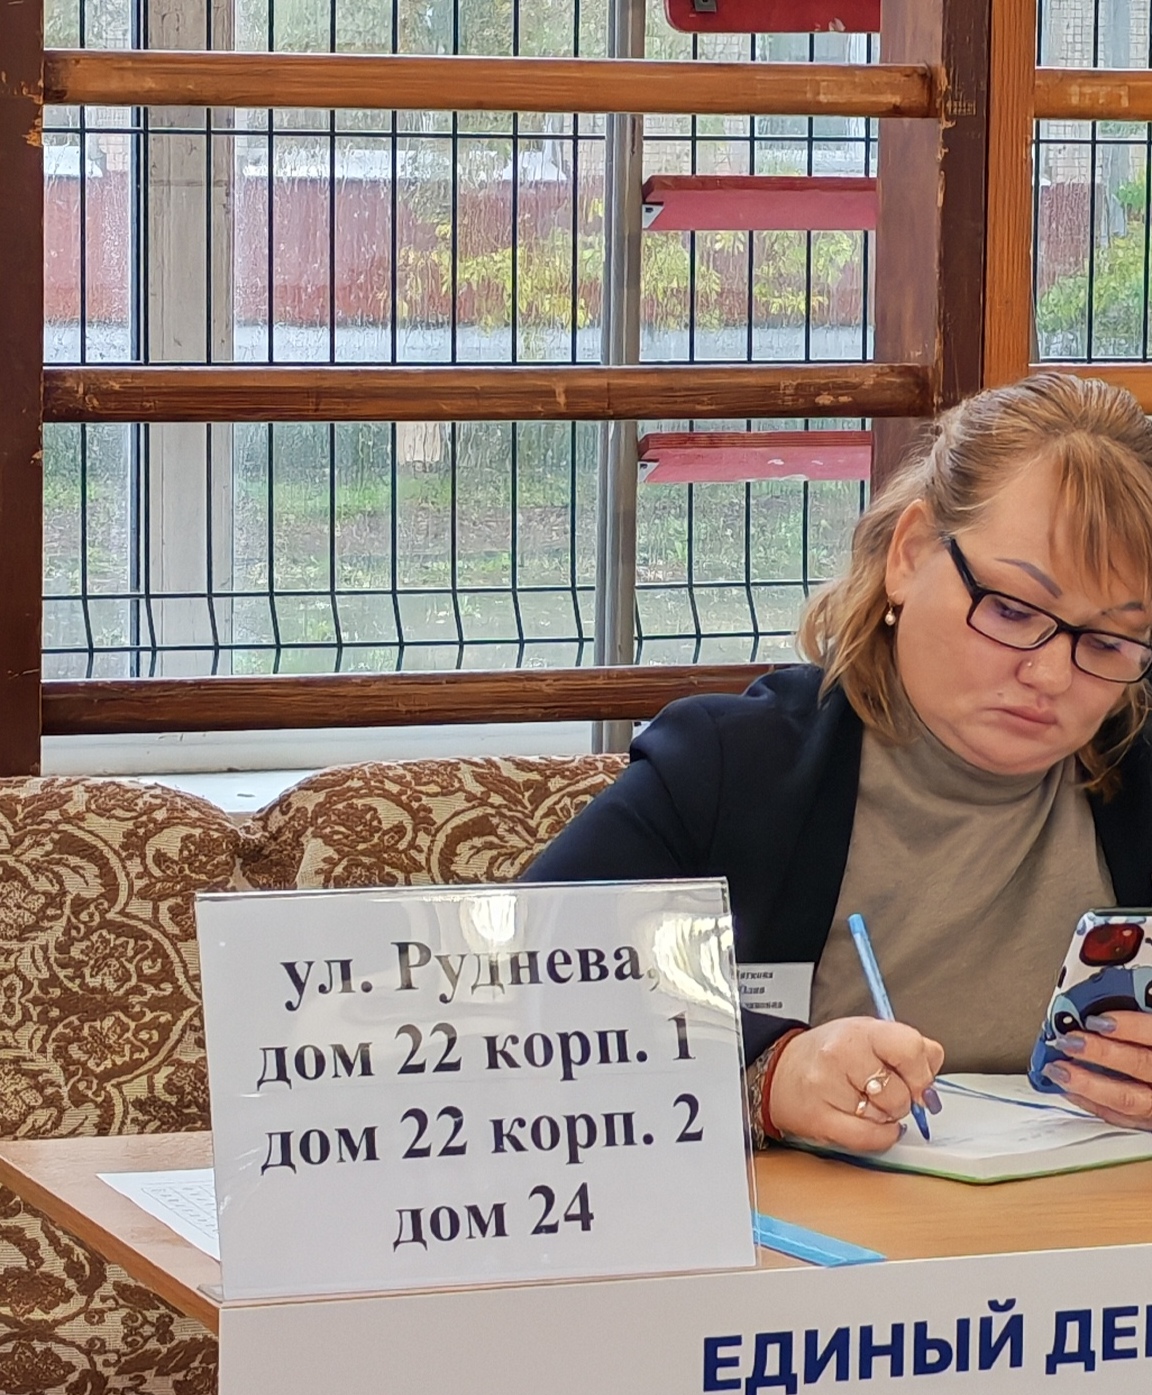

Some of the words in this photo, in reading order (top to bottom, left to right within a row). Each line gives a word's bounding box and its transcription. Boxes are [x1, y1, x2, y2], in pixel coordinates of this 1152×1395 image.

[279, 957, 373, 1012] ул.
[255, 1041, 375, 1091] дом
[395, 1022, 462, 1075] 22
[483, 1028, 648, 1082] корп.
[668, 1010, 694, 1061] 1
[260, 1125, 380, 1176] дом
[400, 1105, 468, 1160] 22
[489, 1114, 654, 1165] корп.
[673, 1093, 704, 1143] 2
[392, 1202, 509, 1252] дом
[528, 1182, 595, 1236] 24
